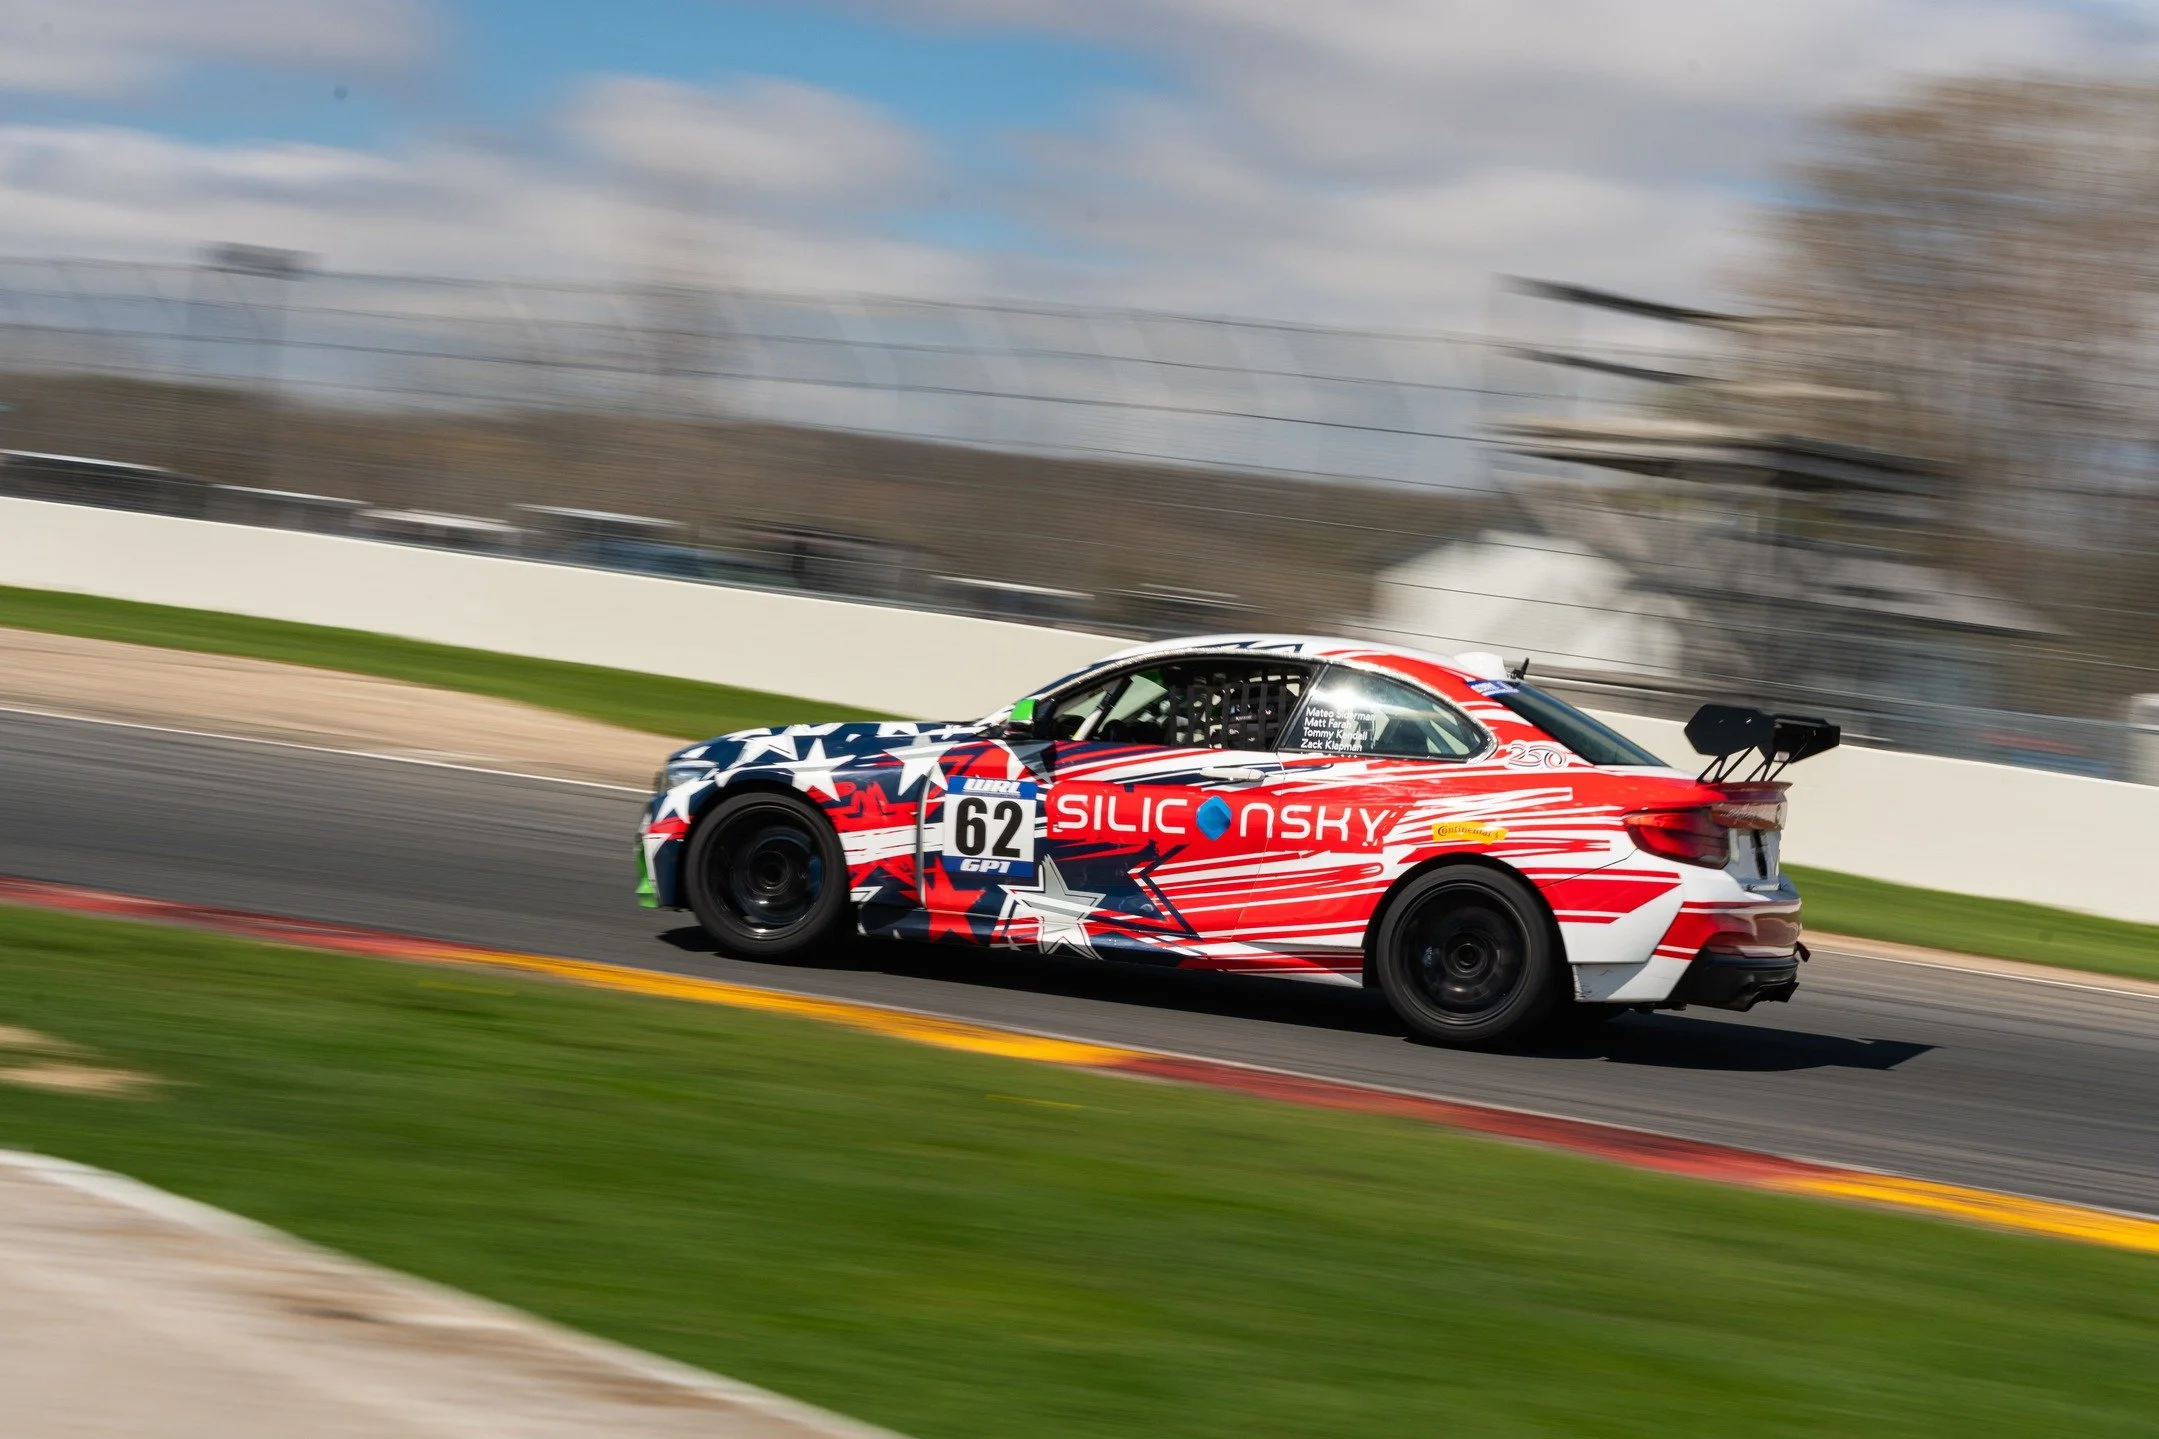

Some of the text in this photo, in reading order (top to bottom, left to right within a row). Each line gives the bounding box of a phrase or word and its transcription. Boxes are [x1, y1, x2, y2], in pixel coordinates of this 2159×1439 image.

[1305, 707, 1334, 719] Mateo
[1304, 717, 1351, 729] Matt Farah
[1303, 727, 1368, 741] Tommy Kendall
[1301, 739, 1362, 752] Zack Klapman
[963, 778, 1021, 794] WRL
[955, 797, 1023, 858] 62
[1438, 826, 1492, 837] Continental
[960, 858, 1011, 874] GP1
